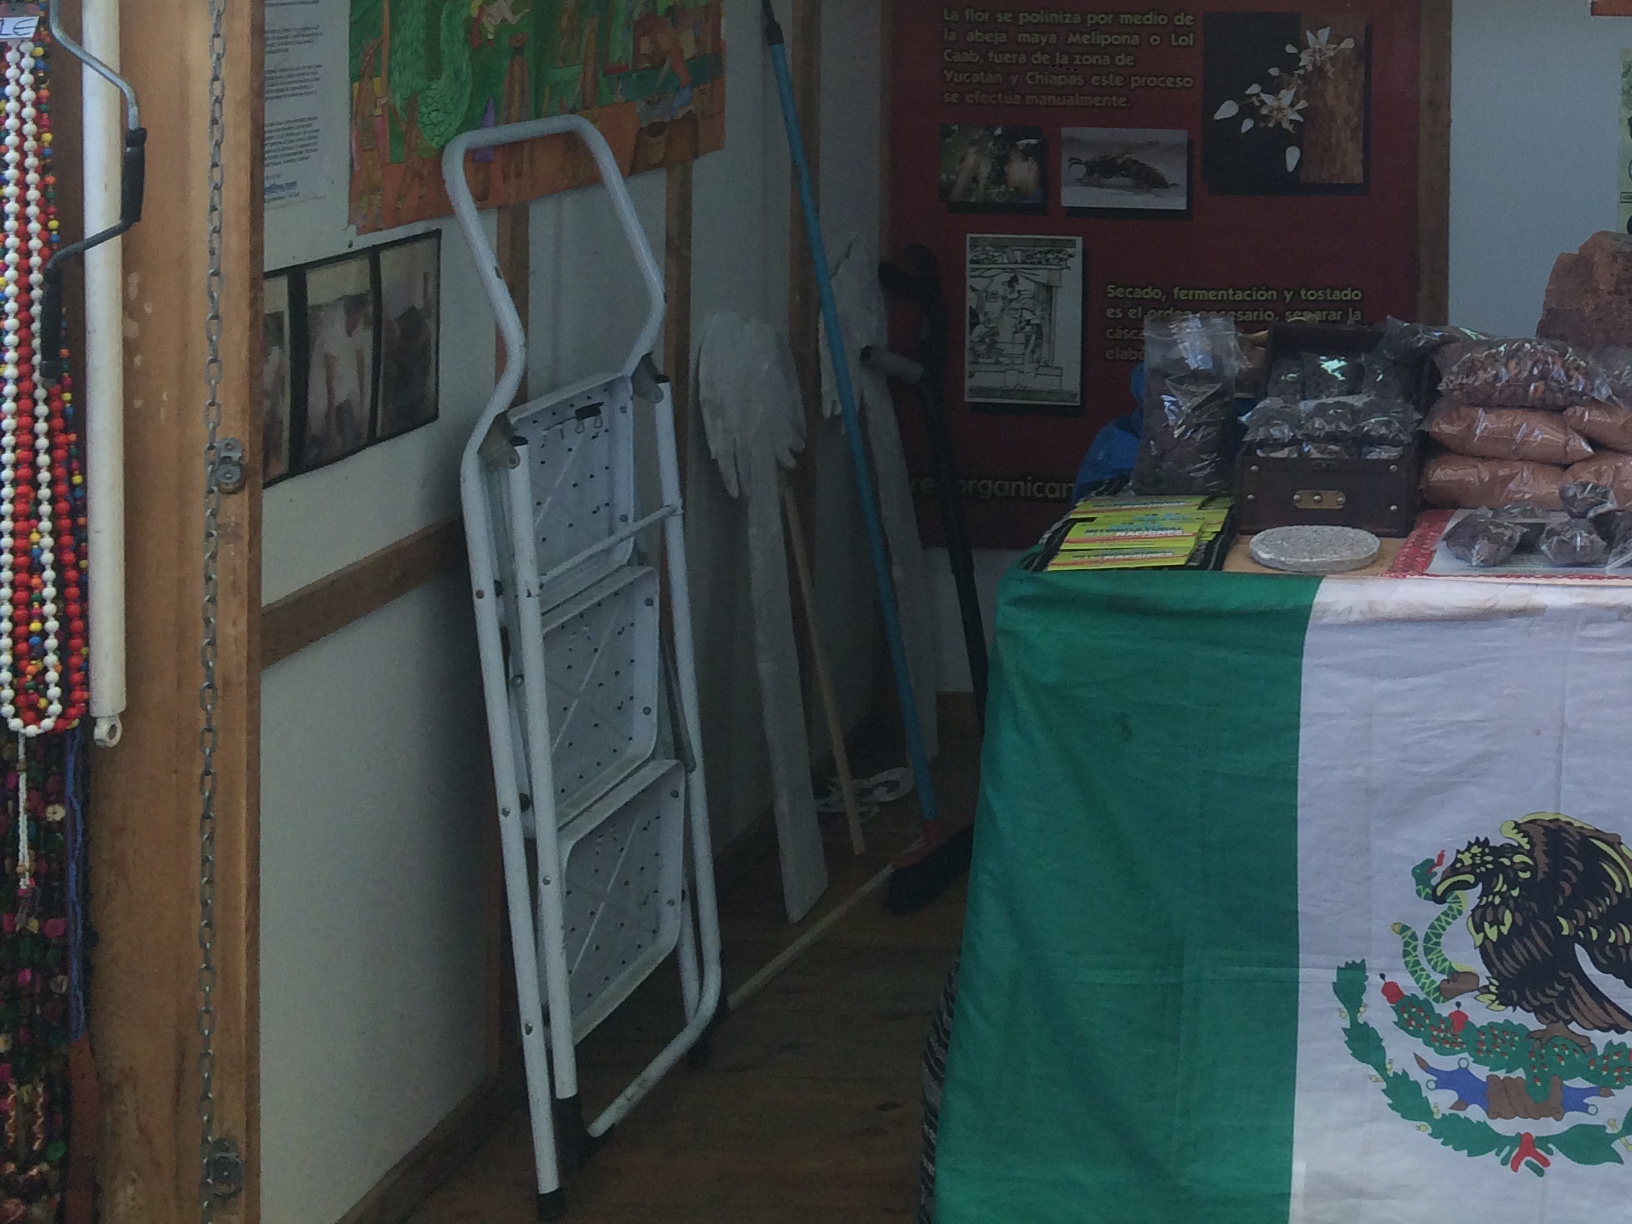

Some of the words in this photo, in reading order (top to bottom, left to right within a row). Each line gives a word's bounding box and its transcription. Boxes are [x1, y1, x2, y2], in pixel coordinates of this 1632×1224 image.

[964, 8, 990, 21] flor
[997, 12, 1012, 23] se
[1018, 11, 1081, 26] poliniza
[1087, 13, 1113, 26] por
[1119, 11, 1168, 25] medio
[1174, 13, 1193, 26] de
[943, 30, 957, 42] la
[966, 30, 1007, 45] abeja
[1017, 34, 1057, 45] maya
[1067, 31, 1139, 46] Melipona
[1031, 51, 1051, 64] de
[1054, 51, 1068, 64] la
[1074, 54, 1110, 65] zona
[1115, 53, 1134, 66] de
[1131, 76, 1193, 90] proceso
[1106, 285, 1166, 302] Secado,
[1173, 286, 1277, 302] fermentación
[1284, 289, 1293, 303] y
[1300, 288, 1362, 301] tostado
[1106, 307, 1122, 318] es
[1128, 306, 1142, 318] el
[1106, 327, 1144, 340] cásca
